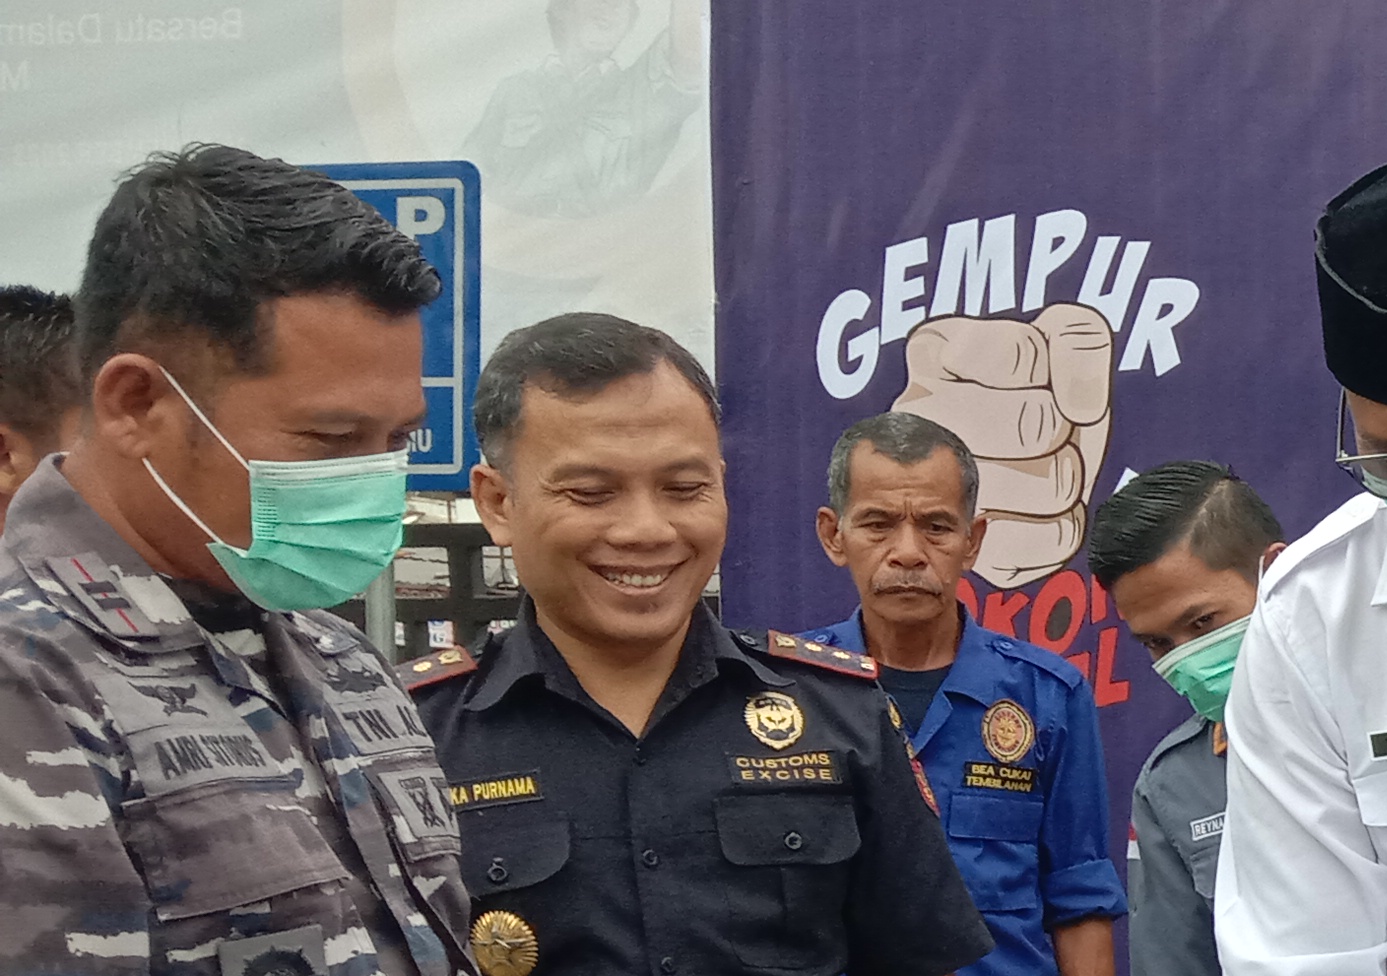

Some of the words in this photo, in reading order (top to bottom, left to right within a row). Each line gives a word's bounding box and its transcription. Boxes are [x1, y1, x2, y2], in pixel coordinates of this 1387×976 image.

[815, 208, 1201, 400] GEMPUR
[736, 752, 830, 769] CUSTOMS
[741, 768, 832, 781] EXCISE
[971, 764, 995, 776] BEA
[1000, 767, 1032, 780] CUKAI
[449, 786, 469, 806] KA
[472, 776, 535, 802] PURNAMA
[1194, 817, 1225, 836] REYNA
